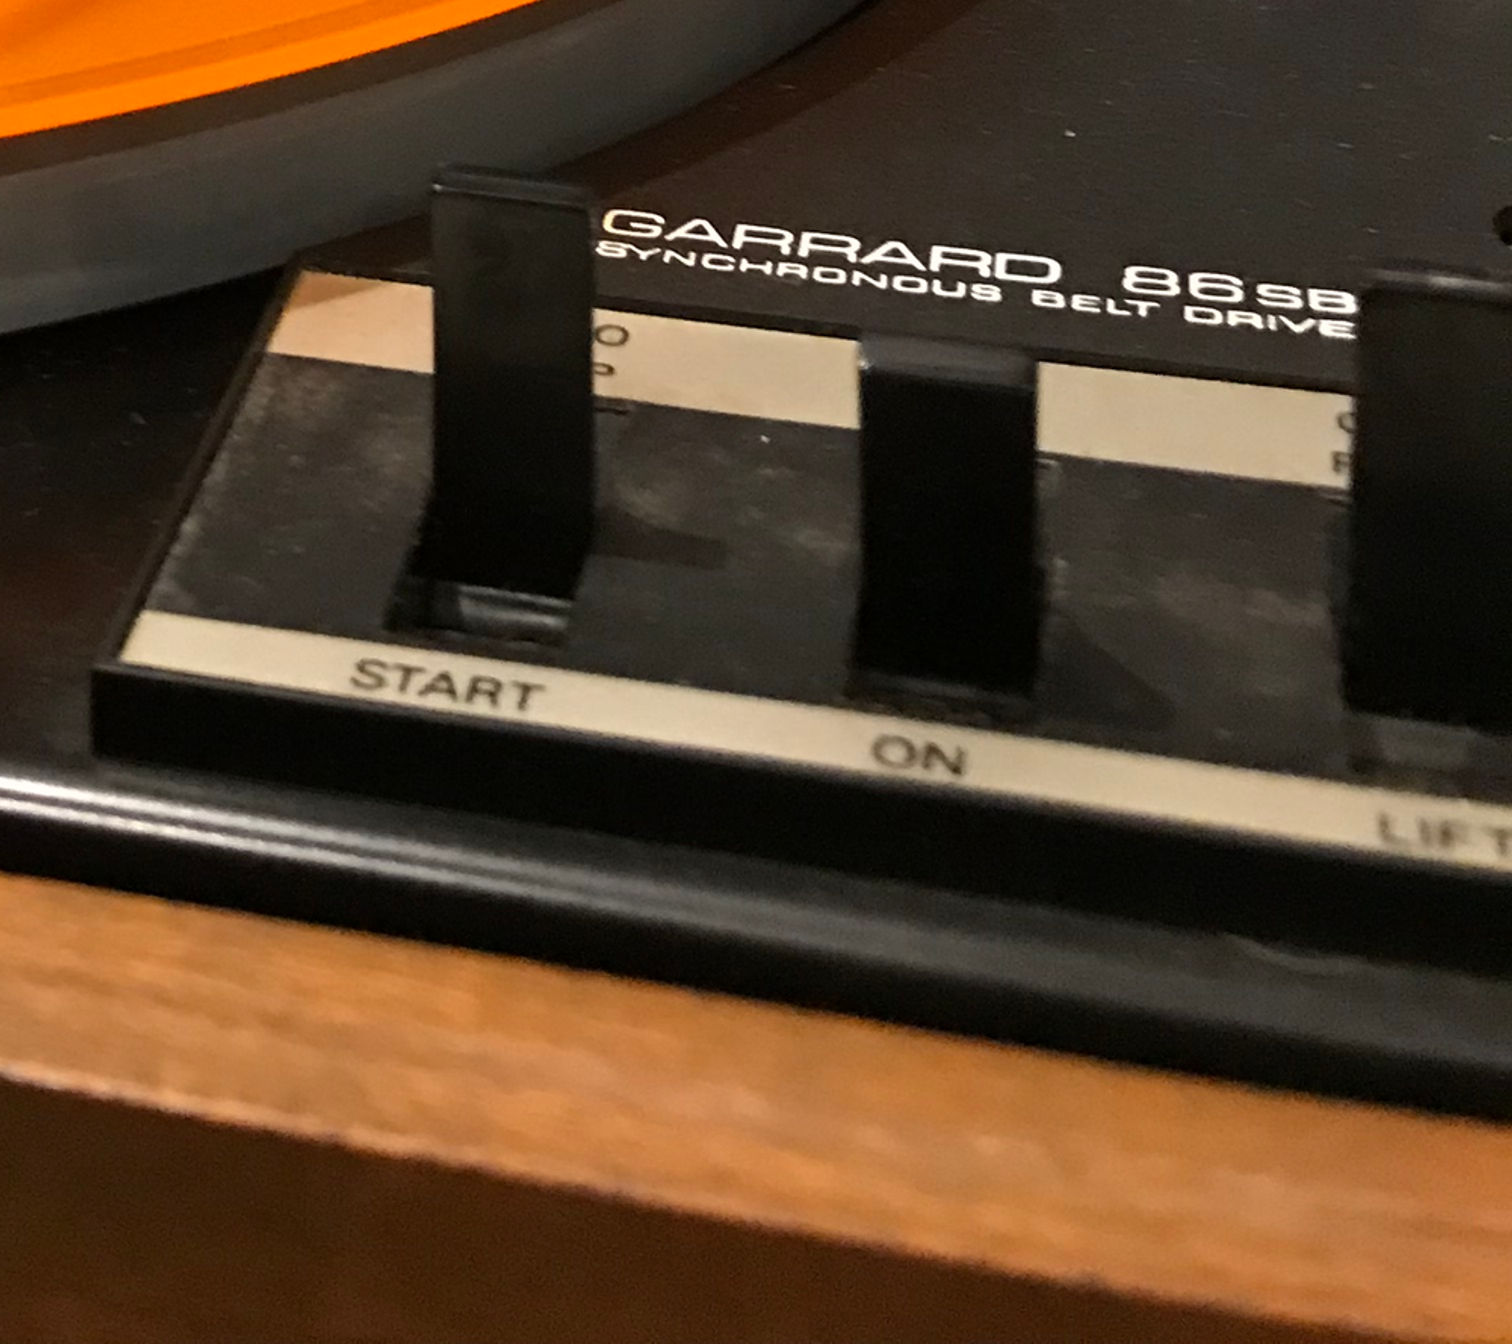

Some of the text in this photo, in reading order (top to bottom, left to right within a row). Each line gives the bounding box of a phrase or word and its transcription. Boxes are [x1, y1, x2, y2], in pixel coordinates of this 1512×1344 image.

[601, 208, 1063, 285] GARRARD
[594, 238, 1358, 341] SYNCHRONOUS BELT DRIVE
[351, 658, 547, 714] START
[871, 733, 969, 779] ON
[1375, 810, 1512, 858] LIFT
